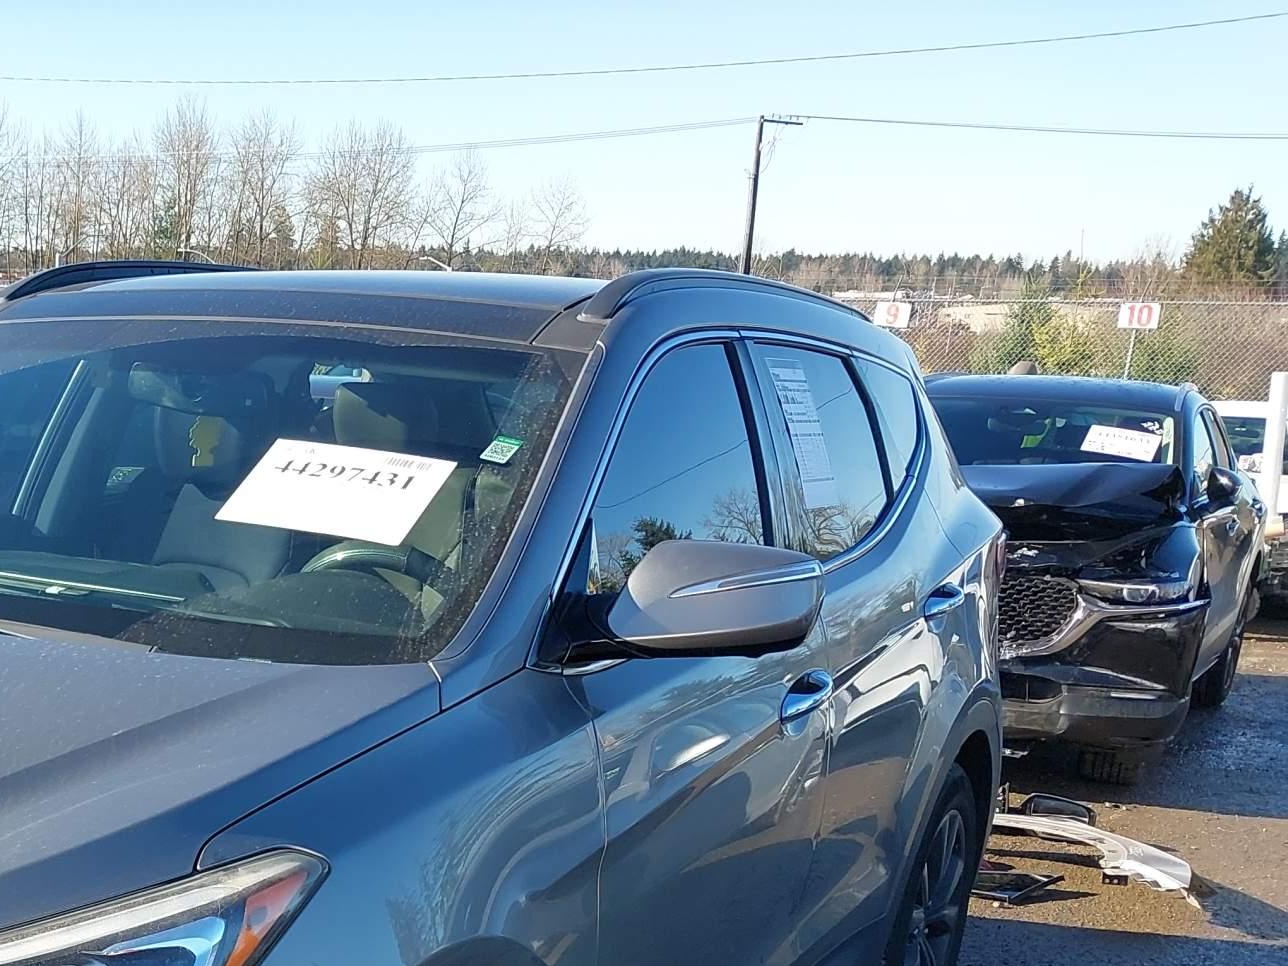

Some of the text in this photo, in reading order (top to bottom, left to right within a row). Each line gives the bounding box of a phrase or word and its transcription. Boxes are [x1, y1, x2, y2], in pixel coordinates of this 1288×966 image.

[885, 303, 900, 325] 9
[1127, 304, 1153, 327] 10
[274, 459, 415, 490] 44297431
